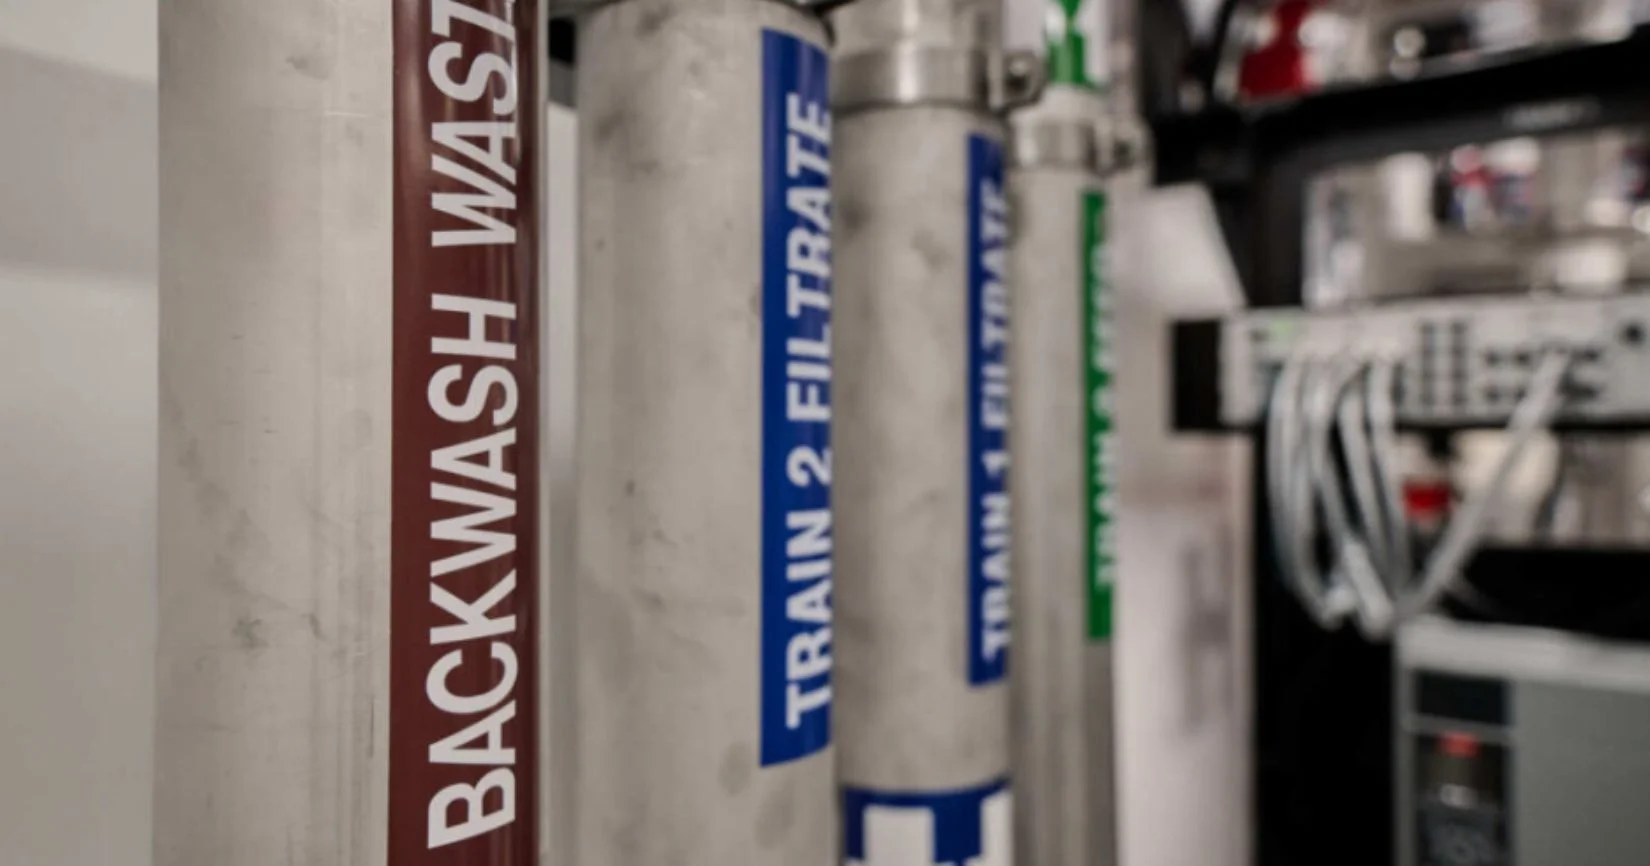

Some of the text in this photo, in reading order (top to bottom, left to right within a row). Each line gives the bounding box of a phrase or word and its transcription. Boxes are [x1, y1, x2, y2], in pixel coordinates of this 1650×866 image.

[425, 0, 518, 849] BACKWASH WAST
[785, 93, 832, 729] TRAIN 2 FILTRATE
[981, 492, 1010, 661] TRAIN
